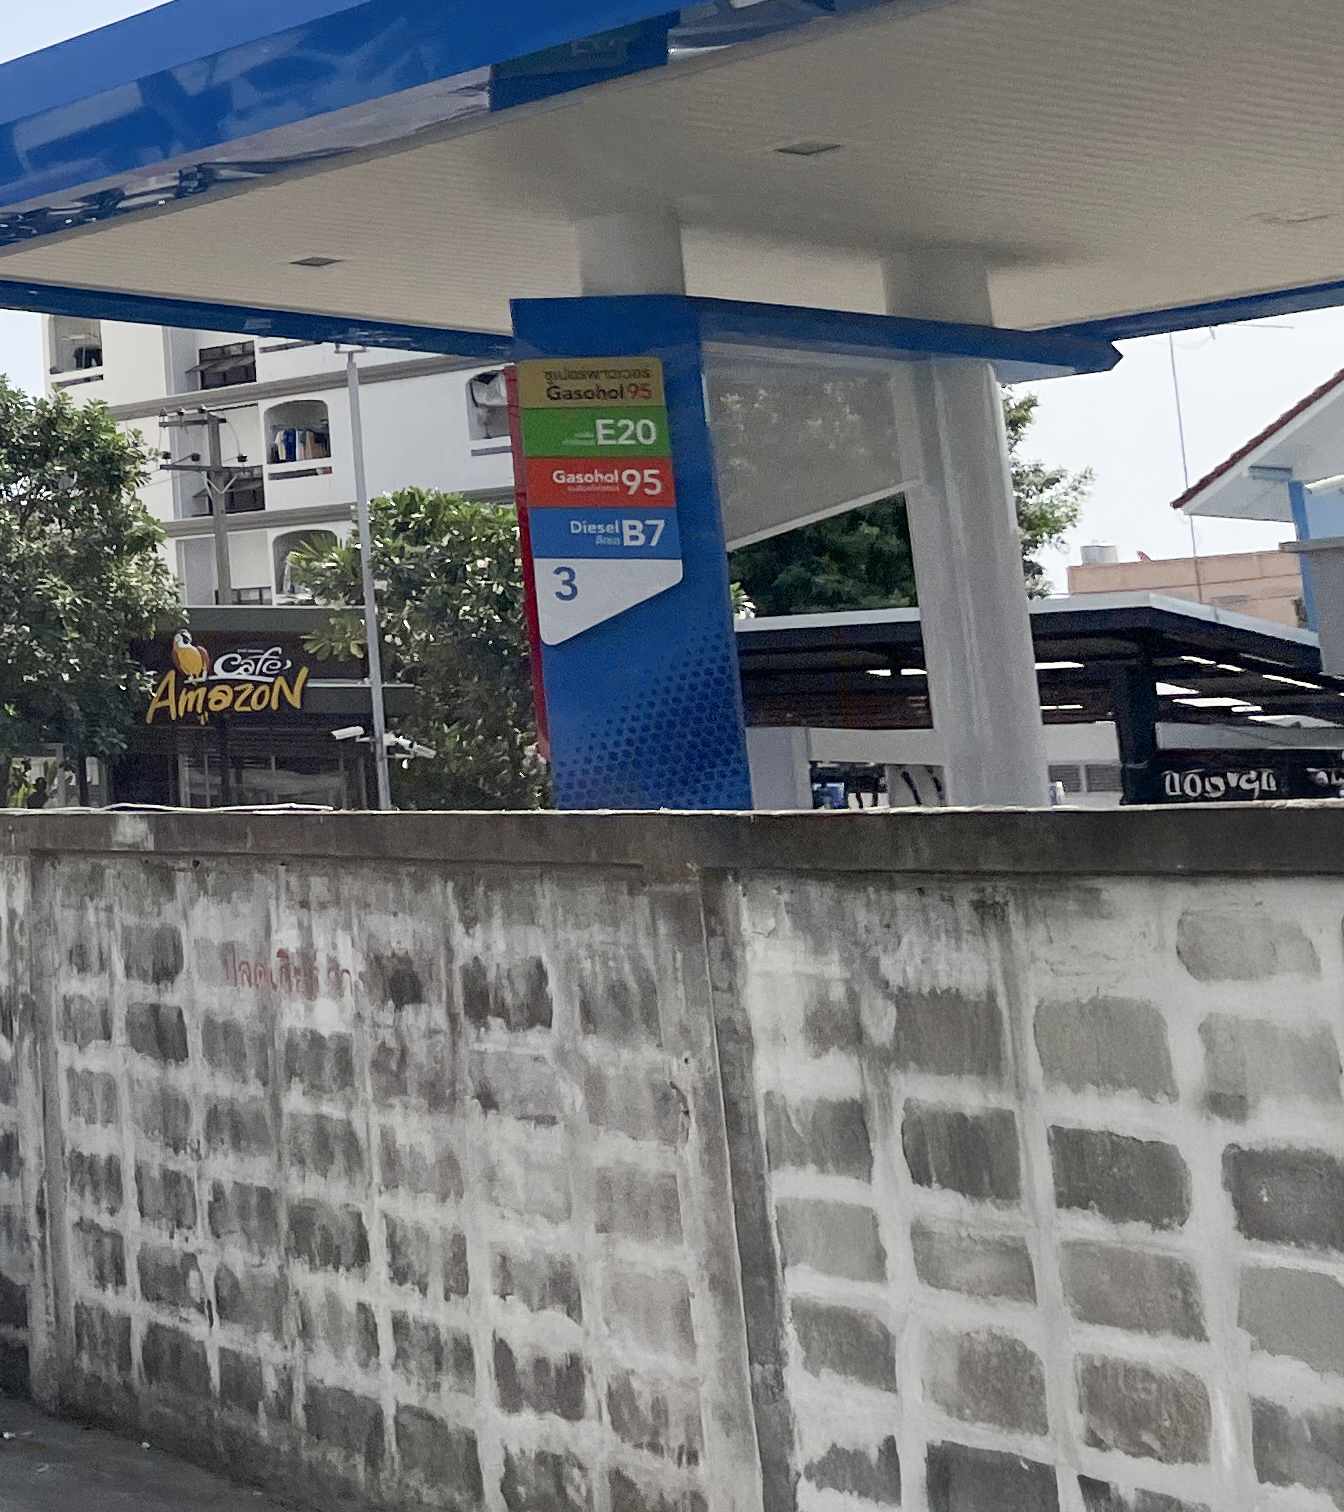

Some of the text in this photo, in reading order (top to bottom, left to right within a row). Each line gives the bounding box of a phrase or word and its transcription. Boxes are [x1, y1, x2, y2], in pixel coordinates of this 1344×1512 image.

[546, 382, 653, 401] Gasohol 95
[595, 418, 657, 445] E20
[552, 468, 662, 496] Gasohol 95
[569, 519, 665, 547] Diesel B7
[552, 566, 578, 601] 3
